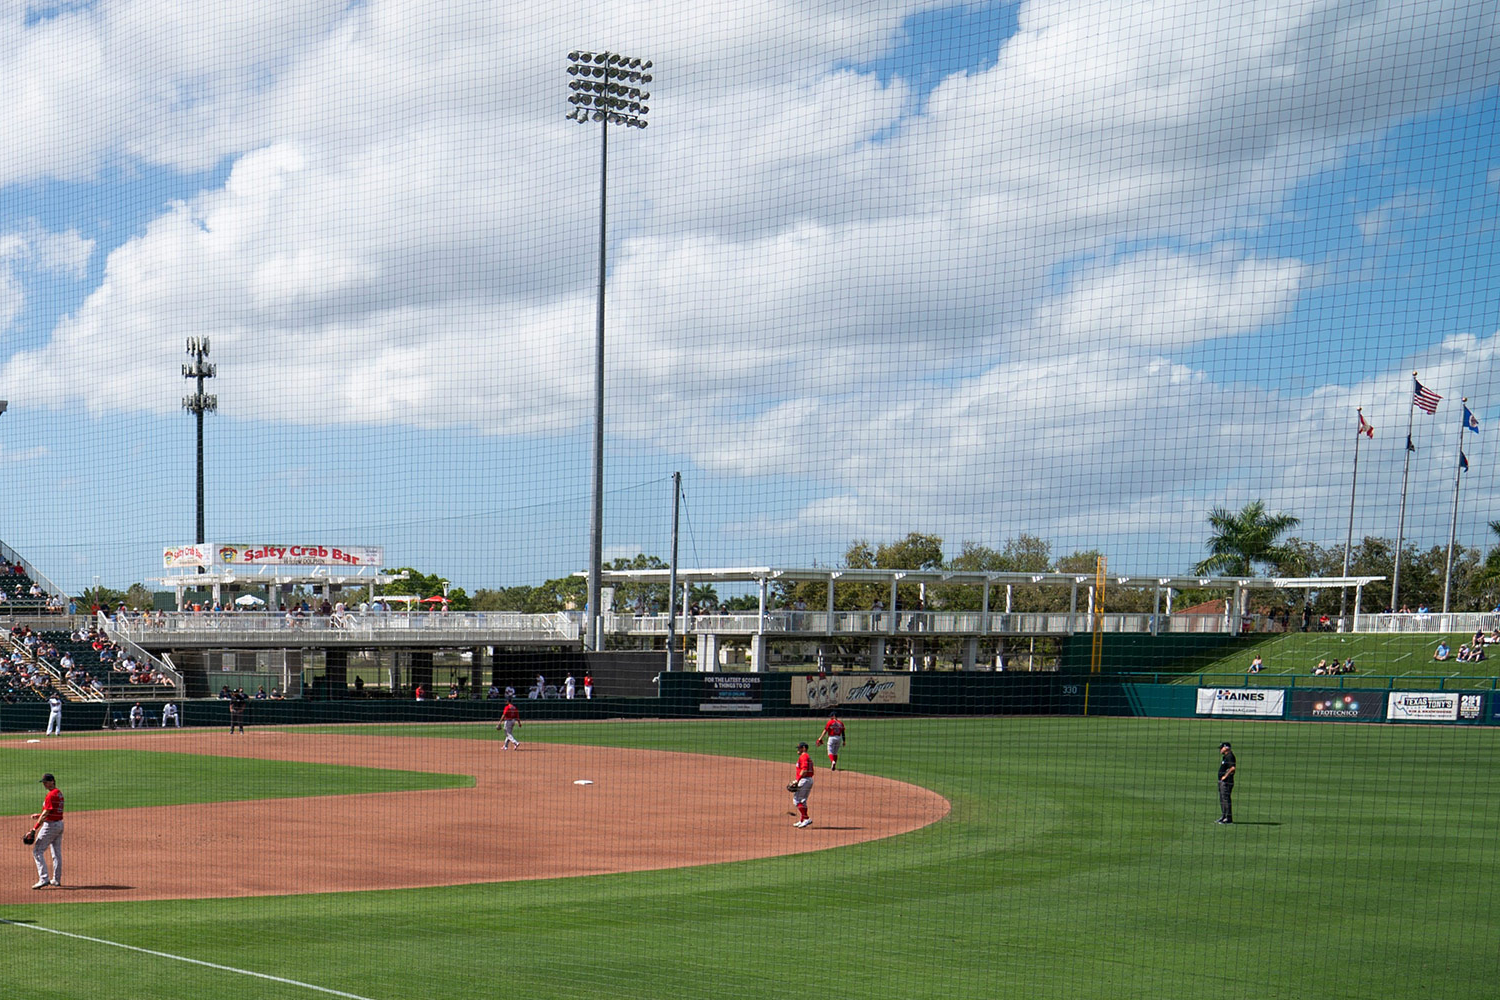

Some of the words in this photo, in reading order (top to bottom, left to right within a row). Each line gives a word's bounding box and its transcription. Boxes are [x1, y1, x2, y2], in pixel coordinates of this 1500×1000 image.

[244, 546, 287, 562] Salty
[290, 545, 329, 558] Crab
[332, 548, 360, 565] Bar
[1062, 685, 1078, 694] 330
[1217, 690, 1265, 701] HAINES
[1405, 697, 1428, 705] TEXAS
[1428, 700, 1452, 708] TONY'S
